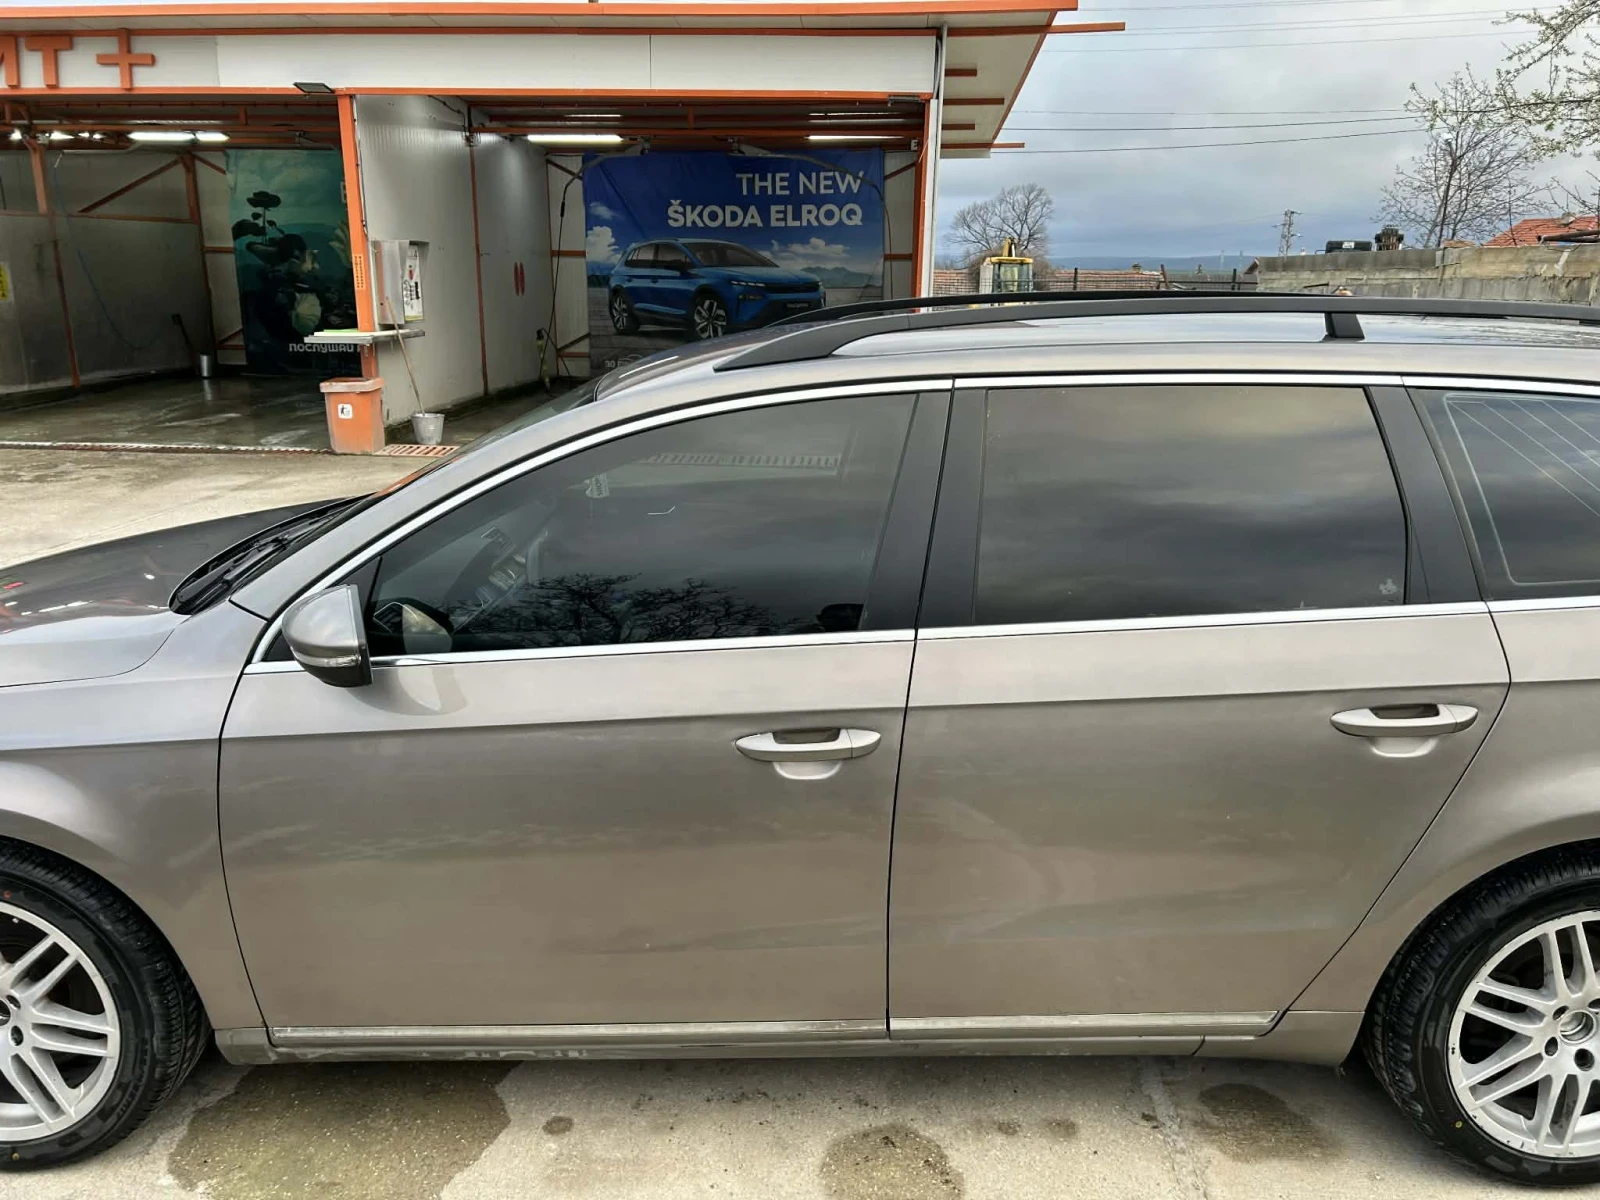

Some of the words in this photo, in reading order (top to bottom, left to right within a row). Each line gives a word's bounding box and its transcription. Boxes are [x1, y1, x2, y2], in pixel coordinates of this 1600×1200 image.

[735, 172, 790, 195] THE
[799, 171, 864, 194] NEW
[667, 200, 763, 227] ŠKODA
[770, 203, 863, 226] ELROQ
